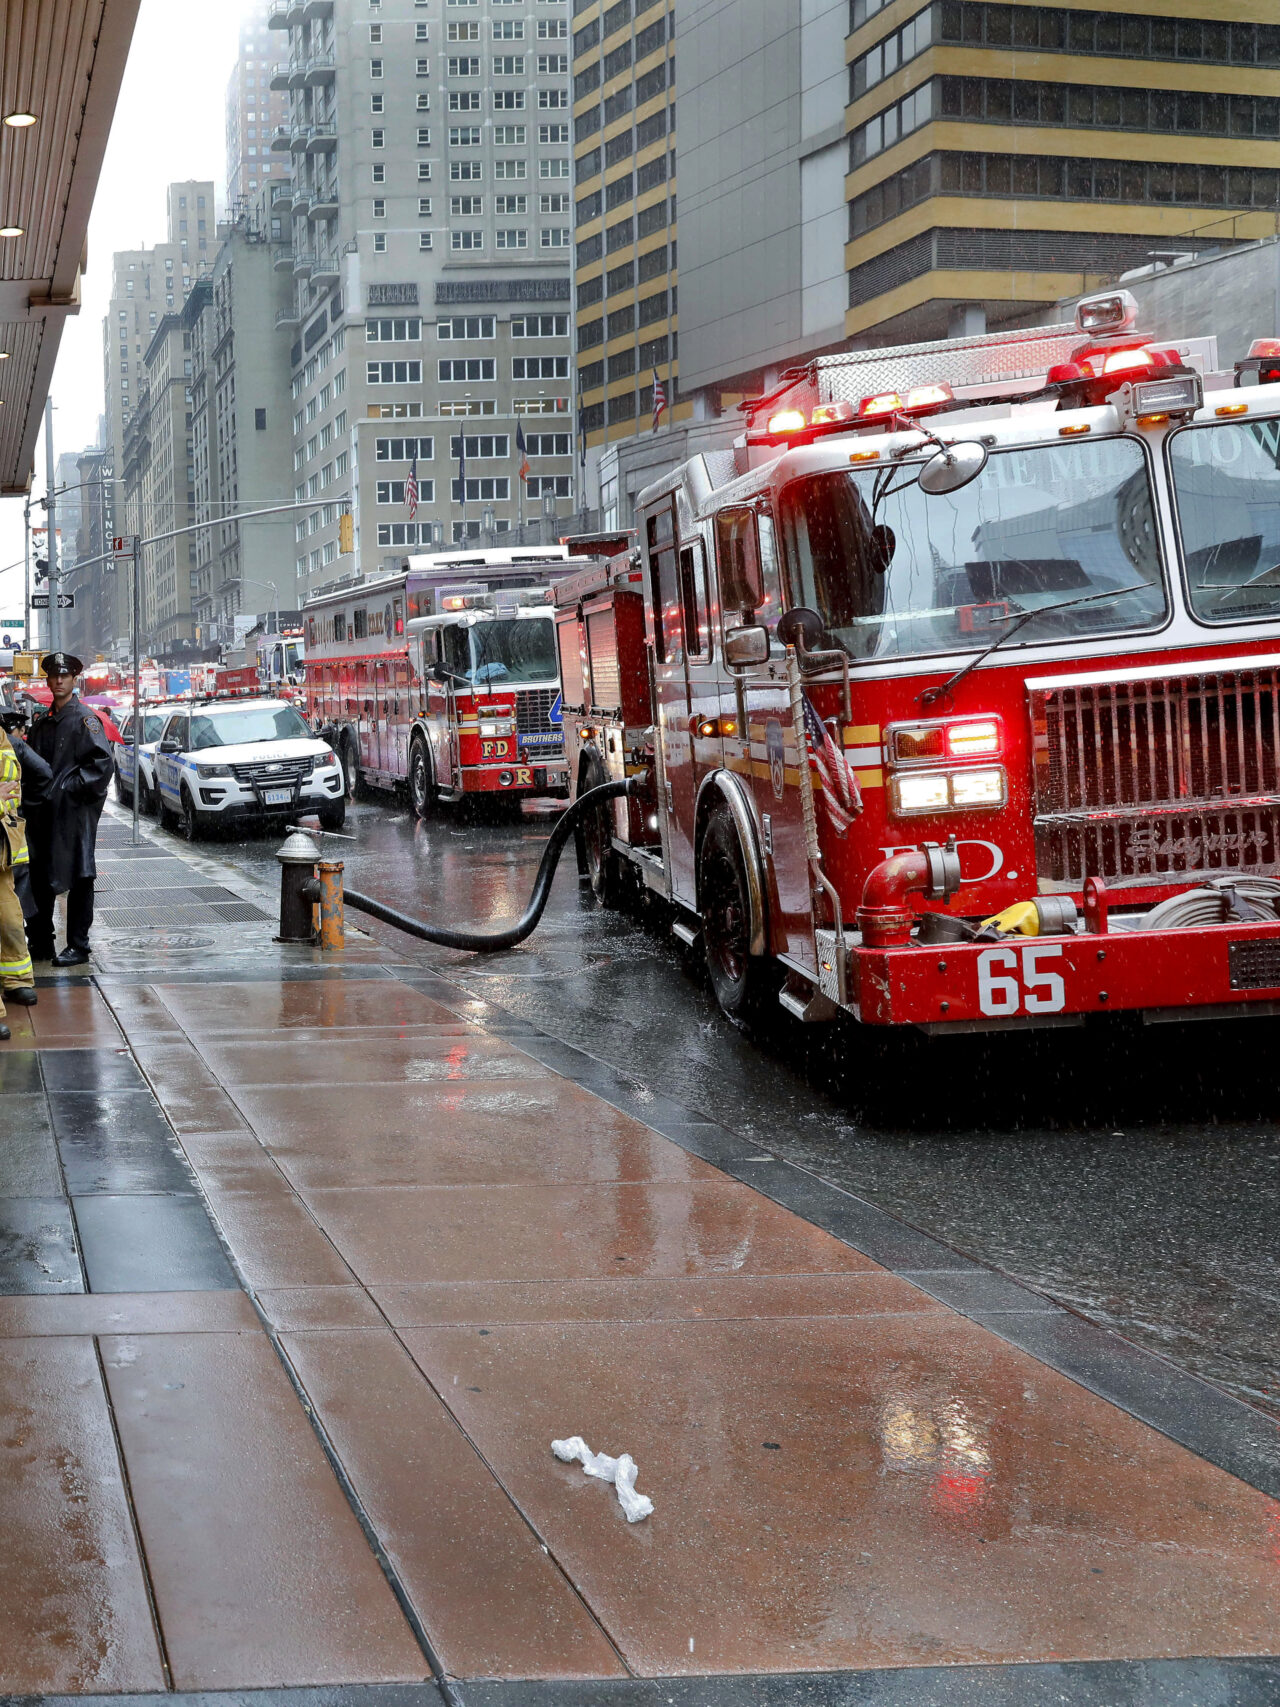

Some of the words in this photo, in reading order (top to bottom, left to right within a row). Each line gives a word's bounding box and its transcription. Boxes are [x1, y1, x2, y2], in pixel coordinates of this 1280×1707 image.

[102, 468, 115, 571] WELLINGTN
[521, 733, 563, 744] BROTHERS
[252, 752, 289, 761] POLICE
[482, 740, 512, 759] F.D.
[515, 768, 532, 786] R
[1126, 829, 1269, 867] Seagrave
[977, 944, 1066, 1017] 65
